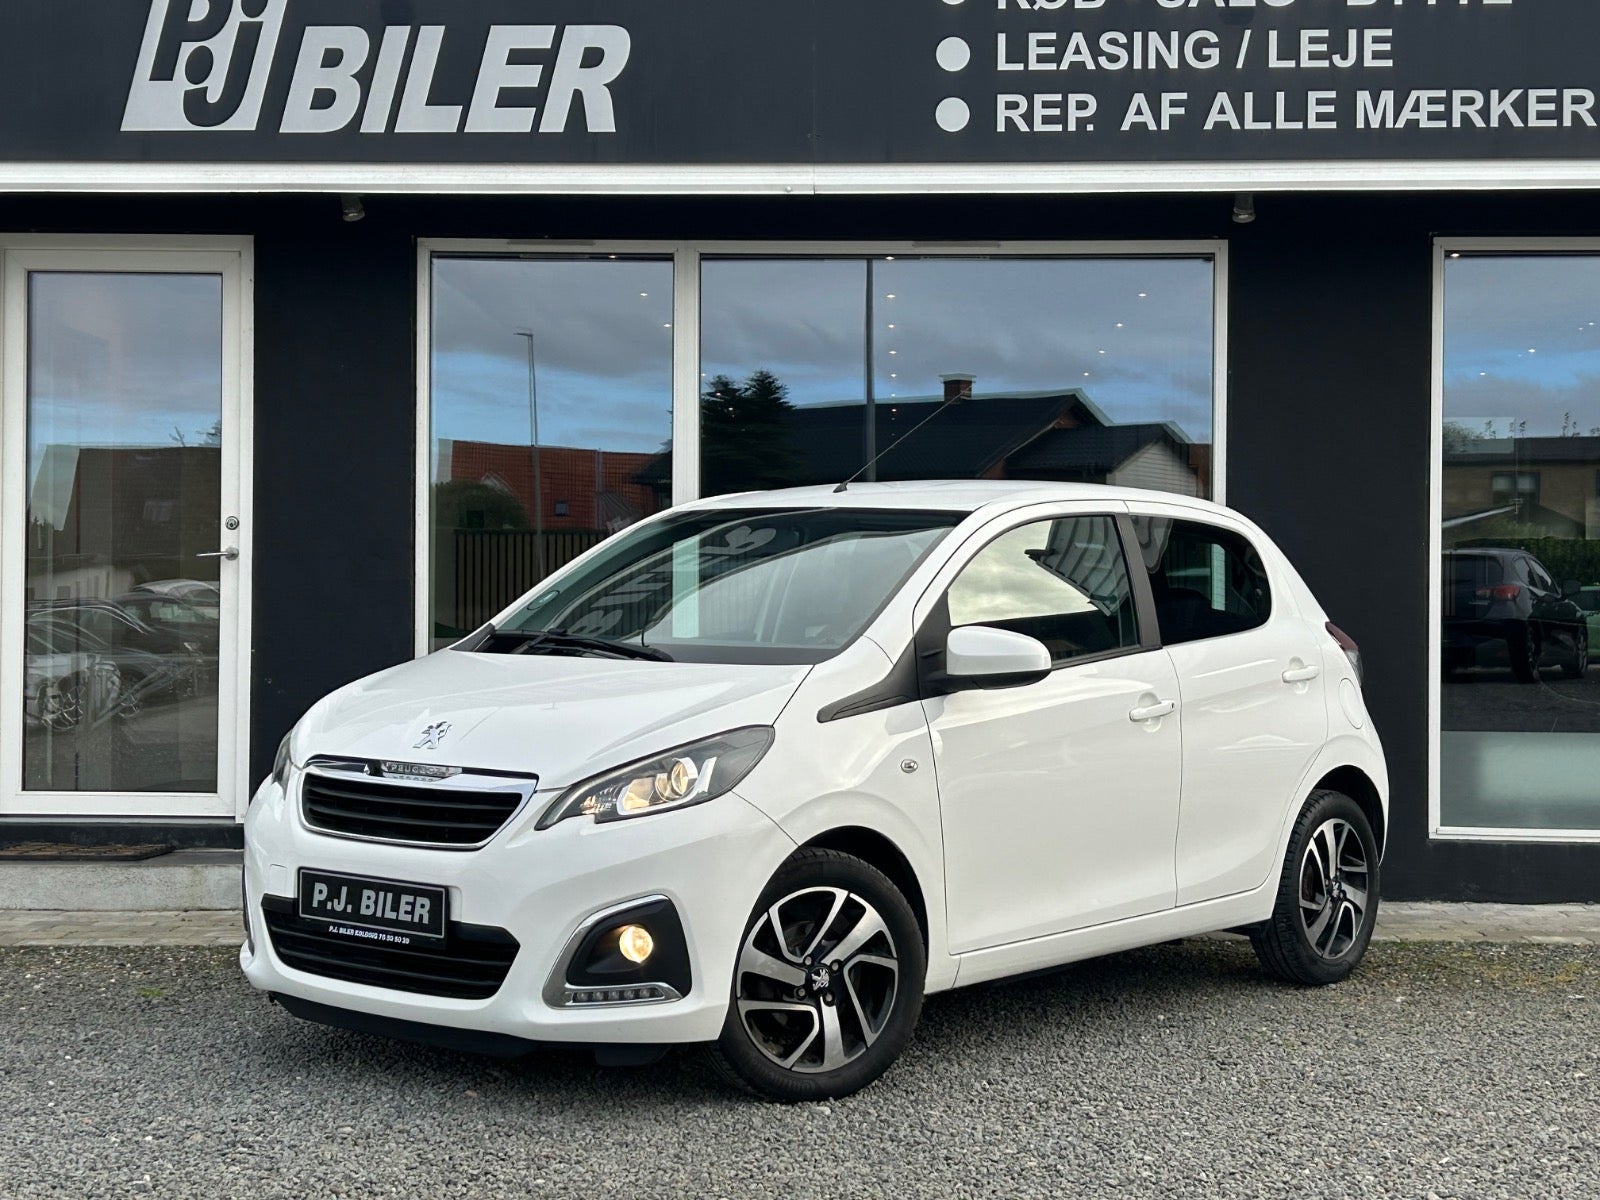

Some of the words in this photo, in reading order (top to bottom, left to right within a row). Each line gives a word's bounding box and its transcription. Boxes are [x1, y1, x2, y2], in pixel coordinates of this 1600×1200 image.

[998, 30, 1220, 71] LEASING
[1236, 30, 1251, 69] /
[1269, 29, 1393, 68] LEJE
[279, 25, 630, 133] BILER
[996, 94, 1097, 132] REP.
[1120, 92, 1187, 131] AF
[1203, 90, 1336, 130] ALLE
[1357, 88, 1598, 129] MÆRKER
[312, 882, 352, 913] P.J.
[360, 889, 430, 924] BILER
[339, 927, 354, 935] BILER
